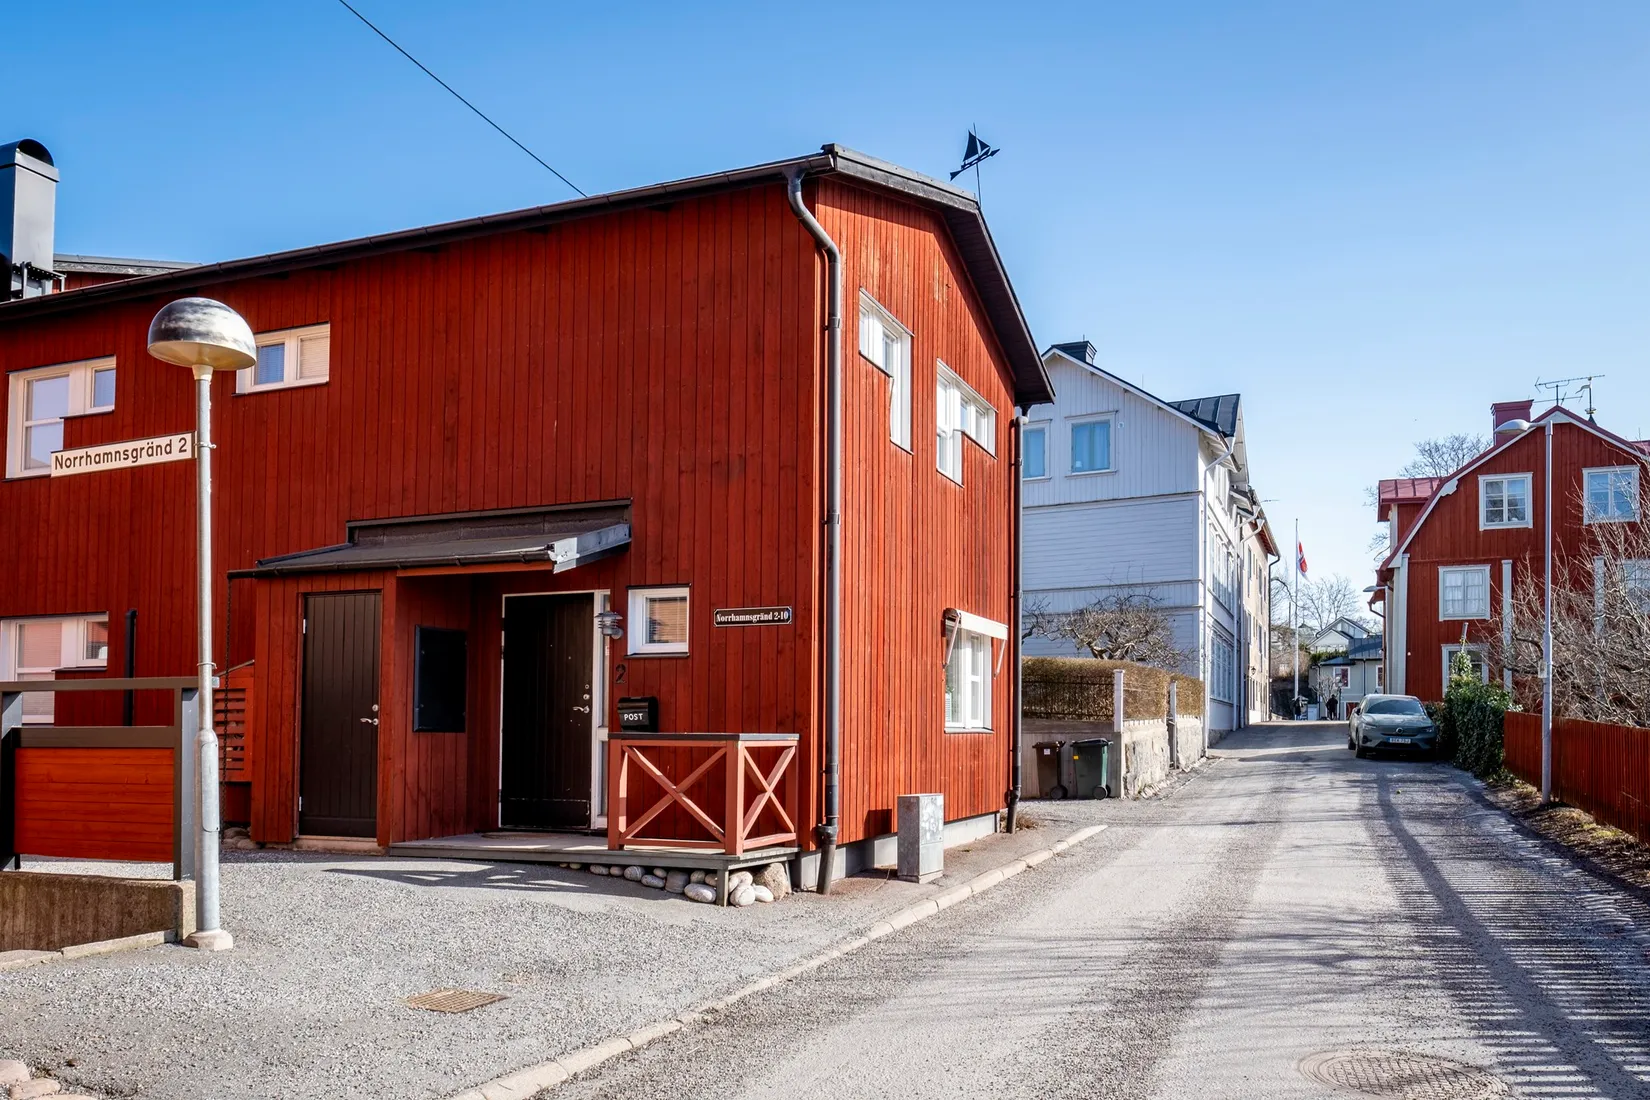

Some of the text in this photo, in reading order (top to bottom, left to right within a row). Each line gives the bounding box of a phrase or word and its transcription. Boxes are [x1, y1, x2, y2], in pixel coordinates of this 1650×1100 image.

[54, 437, 187, 470] Norrhamnsgränd 2
[716, 611, 789, 623] Norrhamnsgränd 2-10
[615, 664, 626, 684] 2
[623, 713, 643, 721] POST
